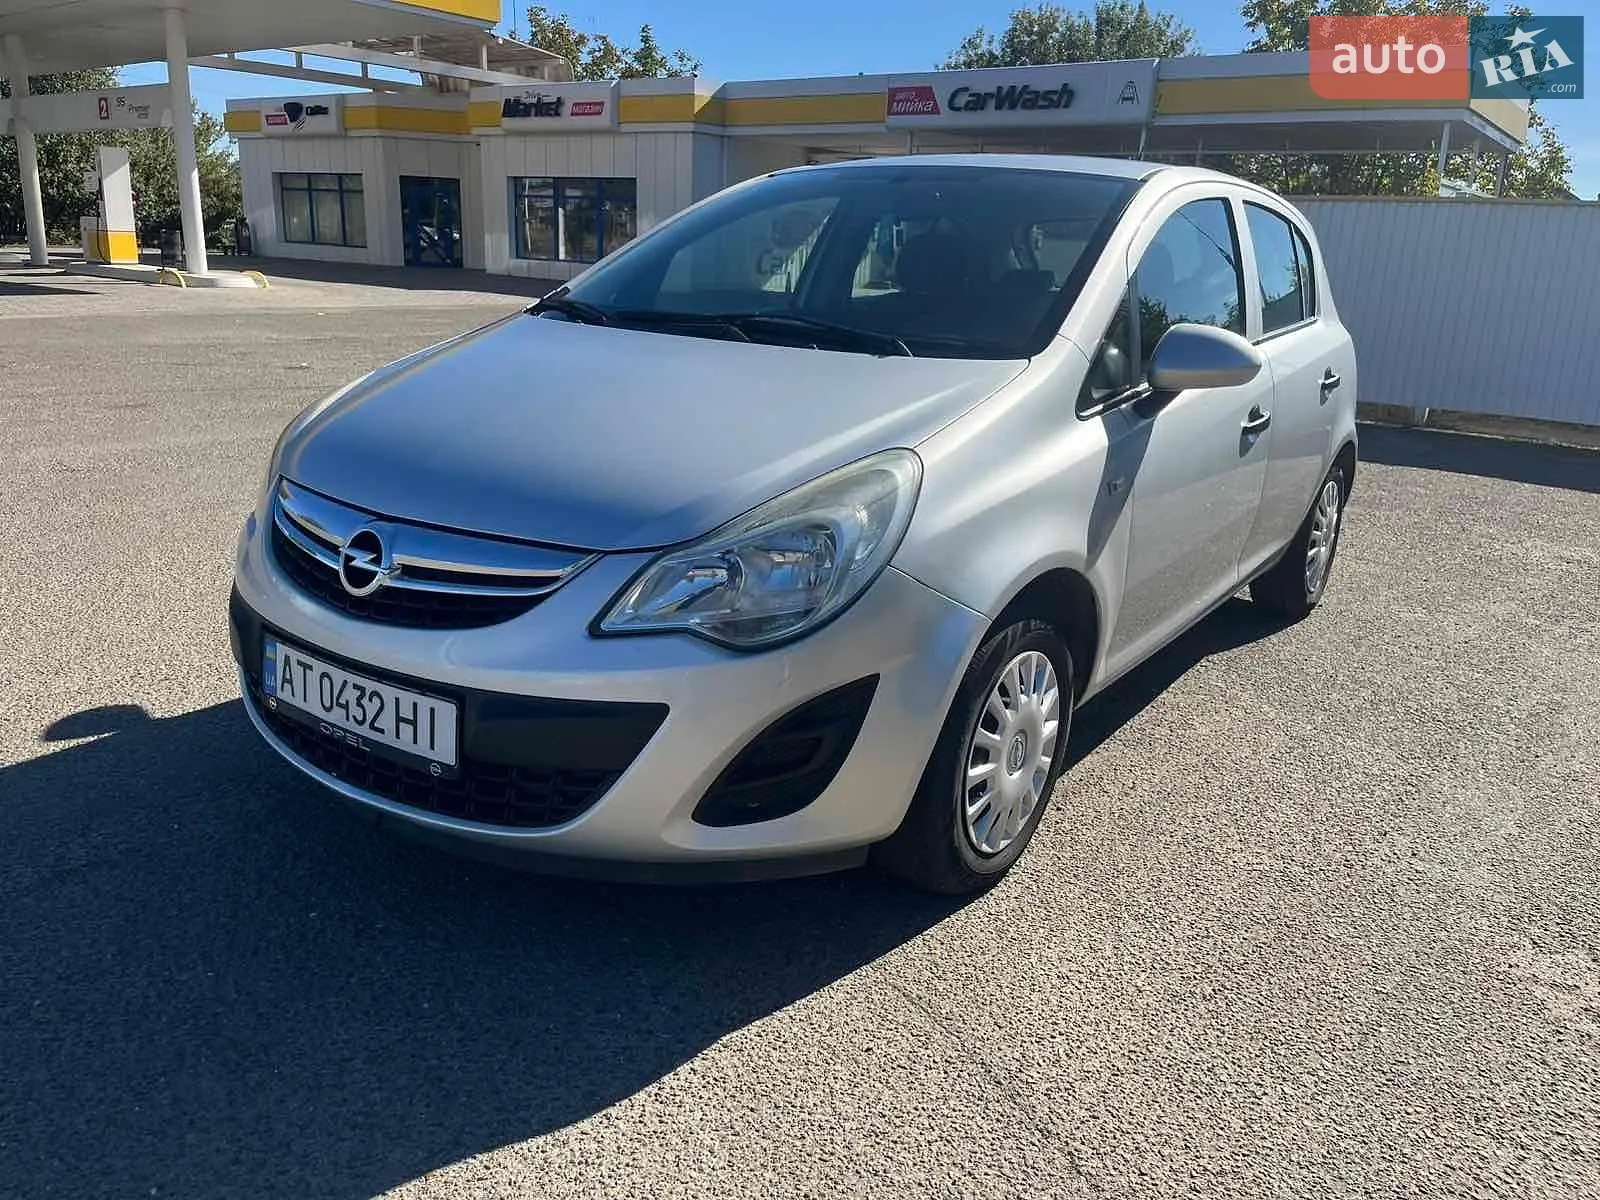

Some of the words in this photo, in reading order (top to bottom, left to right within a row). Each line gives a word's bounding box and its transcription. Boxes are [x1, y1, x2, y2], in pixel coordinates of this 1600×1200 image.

[100, 99, 109, 118] 2
[502, 96, 563, 117] Market
[947, 83, 1075, 112] CarWash
[265, 671, 276, 688] UA
[280, 654, 313, 703] AT
[319, 672, 385, 735] 0432
[395, 696, 435, 751] HI
[320, 722, 371, 752] OPEL
